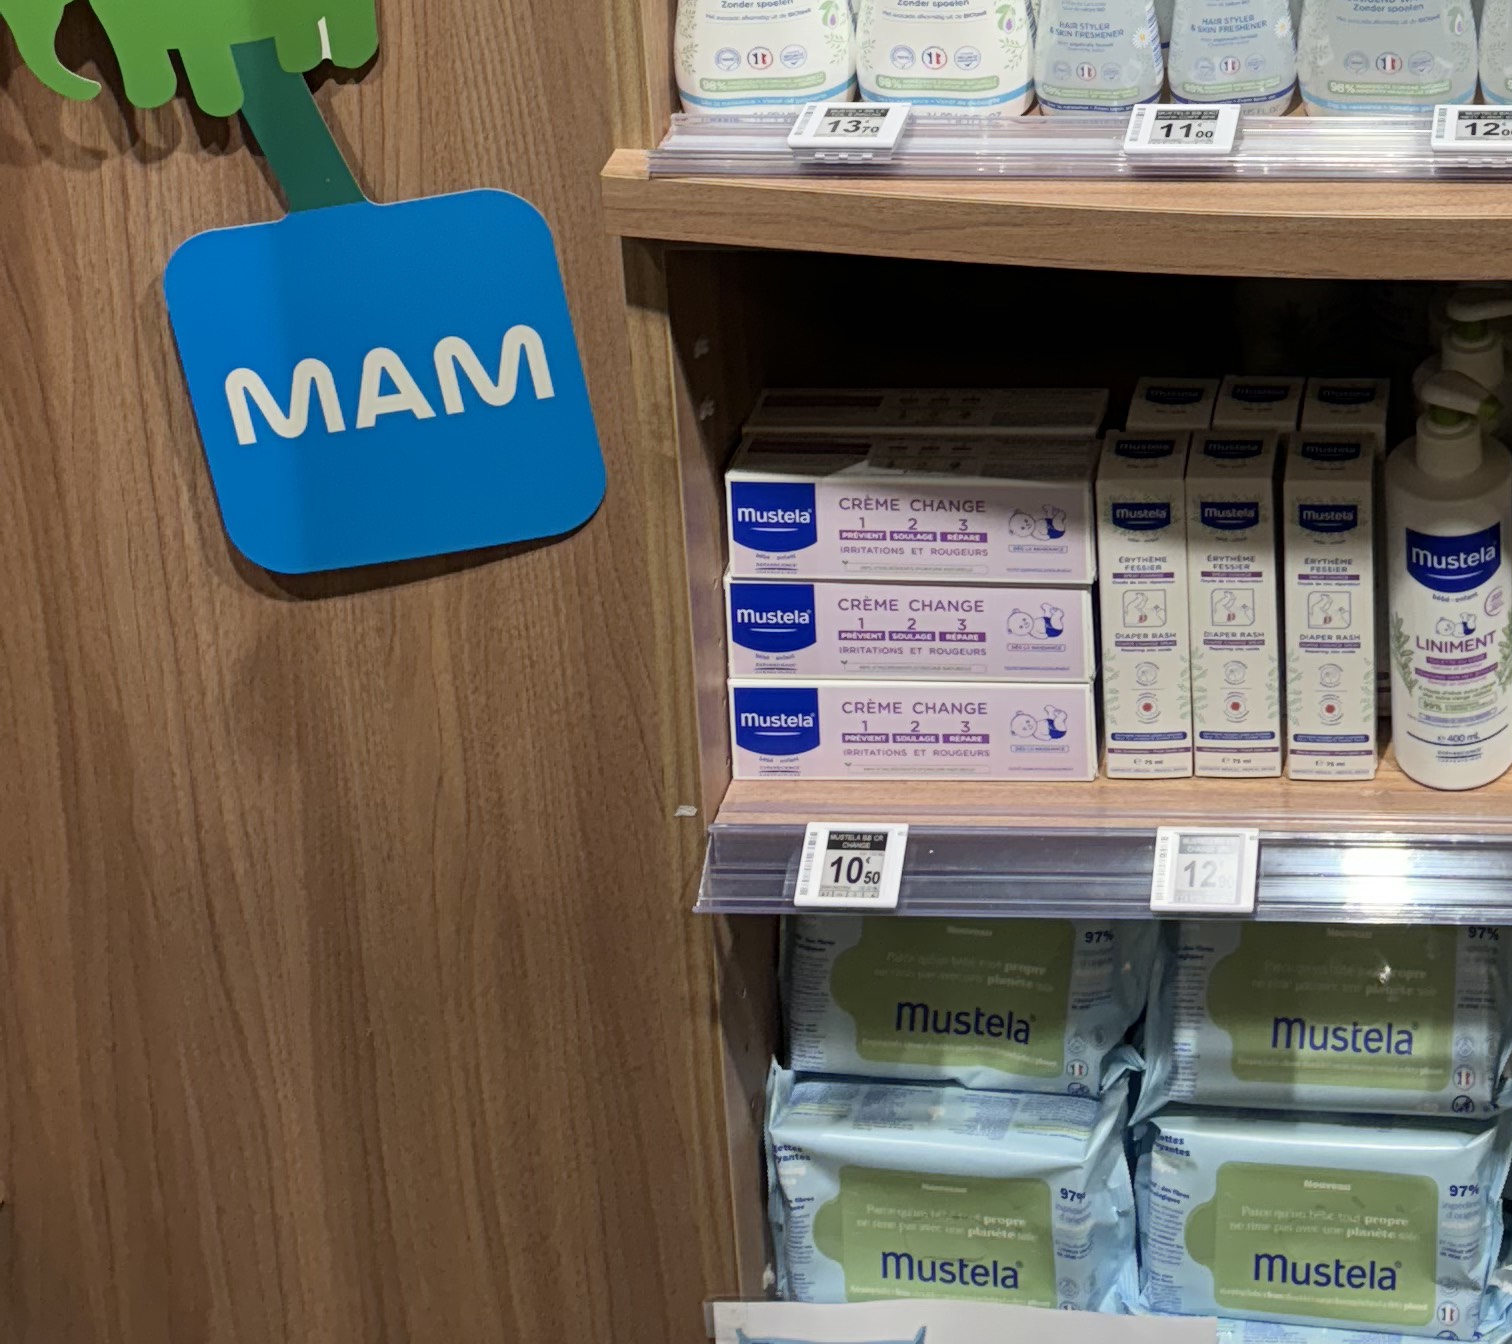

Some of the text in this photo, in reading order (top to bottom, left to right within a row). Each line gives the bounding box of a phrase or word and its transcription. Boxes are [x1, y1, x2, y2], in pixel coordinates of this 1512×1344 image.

[225, 325, 555, 446] MAM
[839, 495, 986, 513] CRÈME CHANGE
[738, 508, 811, 523] Mustela
[838, 596, 984, 613] CRÈME CHANGE
[737, 609, 809, 624] Mustela
